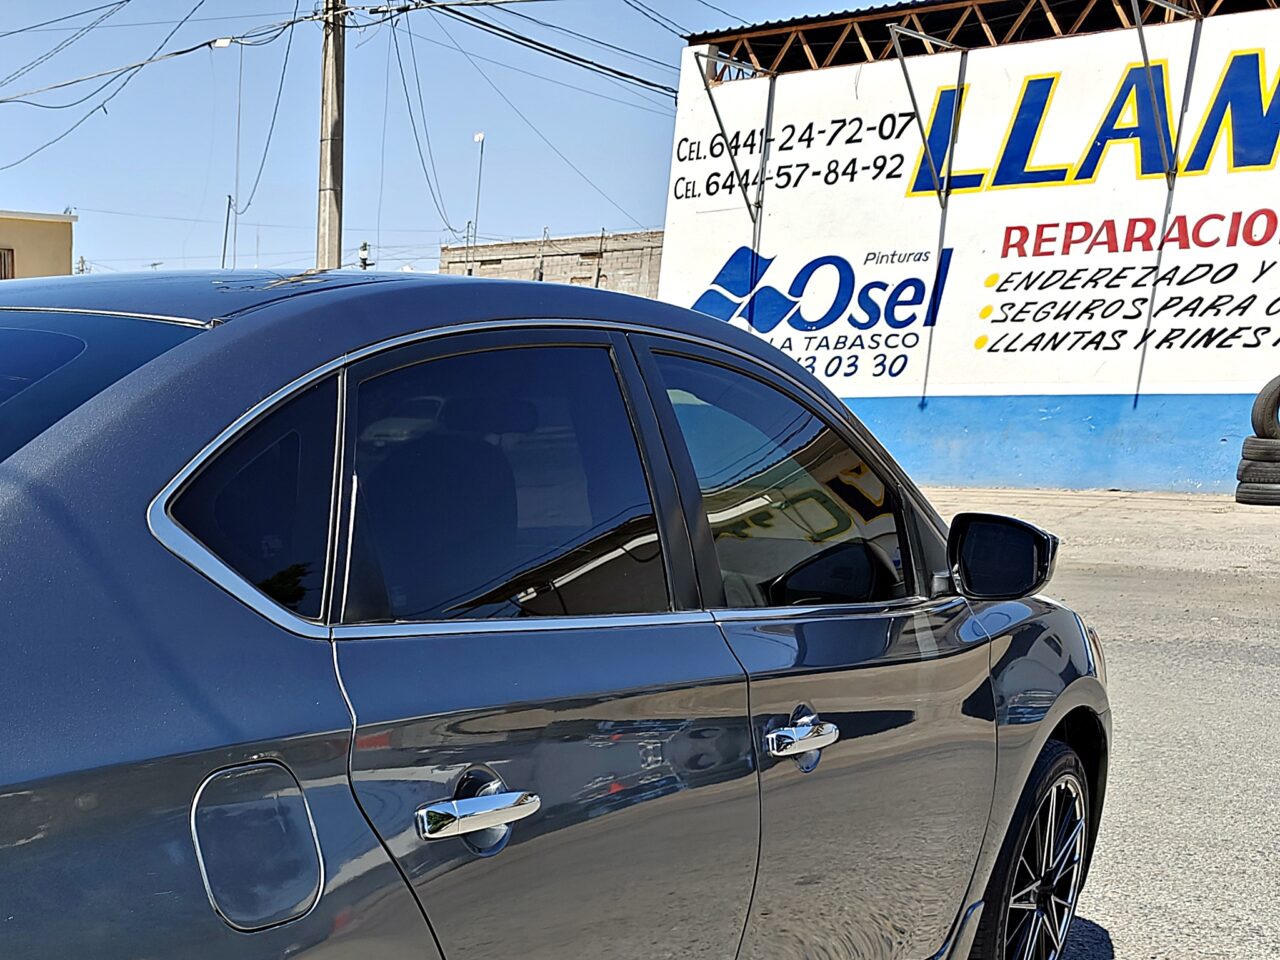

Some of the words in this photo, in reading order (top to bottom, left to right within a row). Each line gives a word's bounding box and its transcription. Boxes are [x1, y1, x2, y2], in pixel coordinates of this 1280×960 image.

[1001, 208, 1280, 258] REPARACIO
[864, 250, 931, 265] Pinturas
[787, 248, 954, 332] Osel
[995, 263, 1238, 292] ENDEREZADO
[1252, 260, 1278, 283] Y
[991, 297, 1149, 323] SEGUROS
[1153, 293, 1258, 318] PARA
[803, 332, 920, 351] TABASCO
[987, 330, 1128, 353] LLANTAS
[1134, 327, 1157, 350] Y
[1155, 326, 1271, 350] RINES
[824, 354, 860, 378] 03
[872, 353, 908, 378] 30
